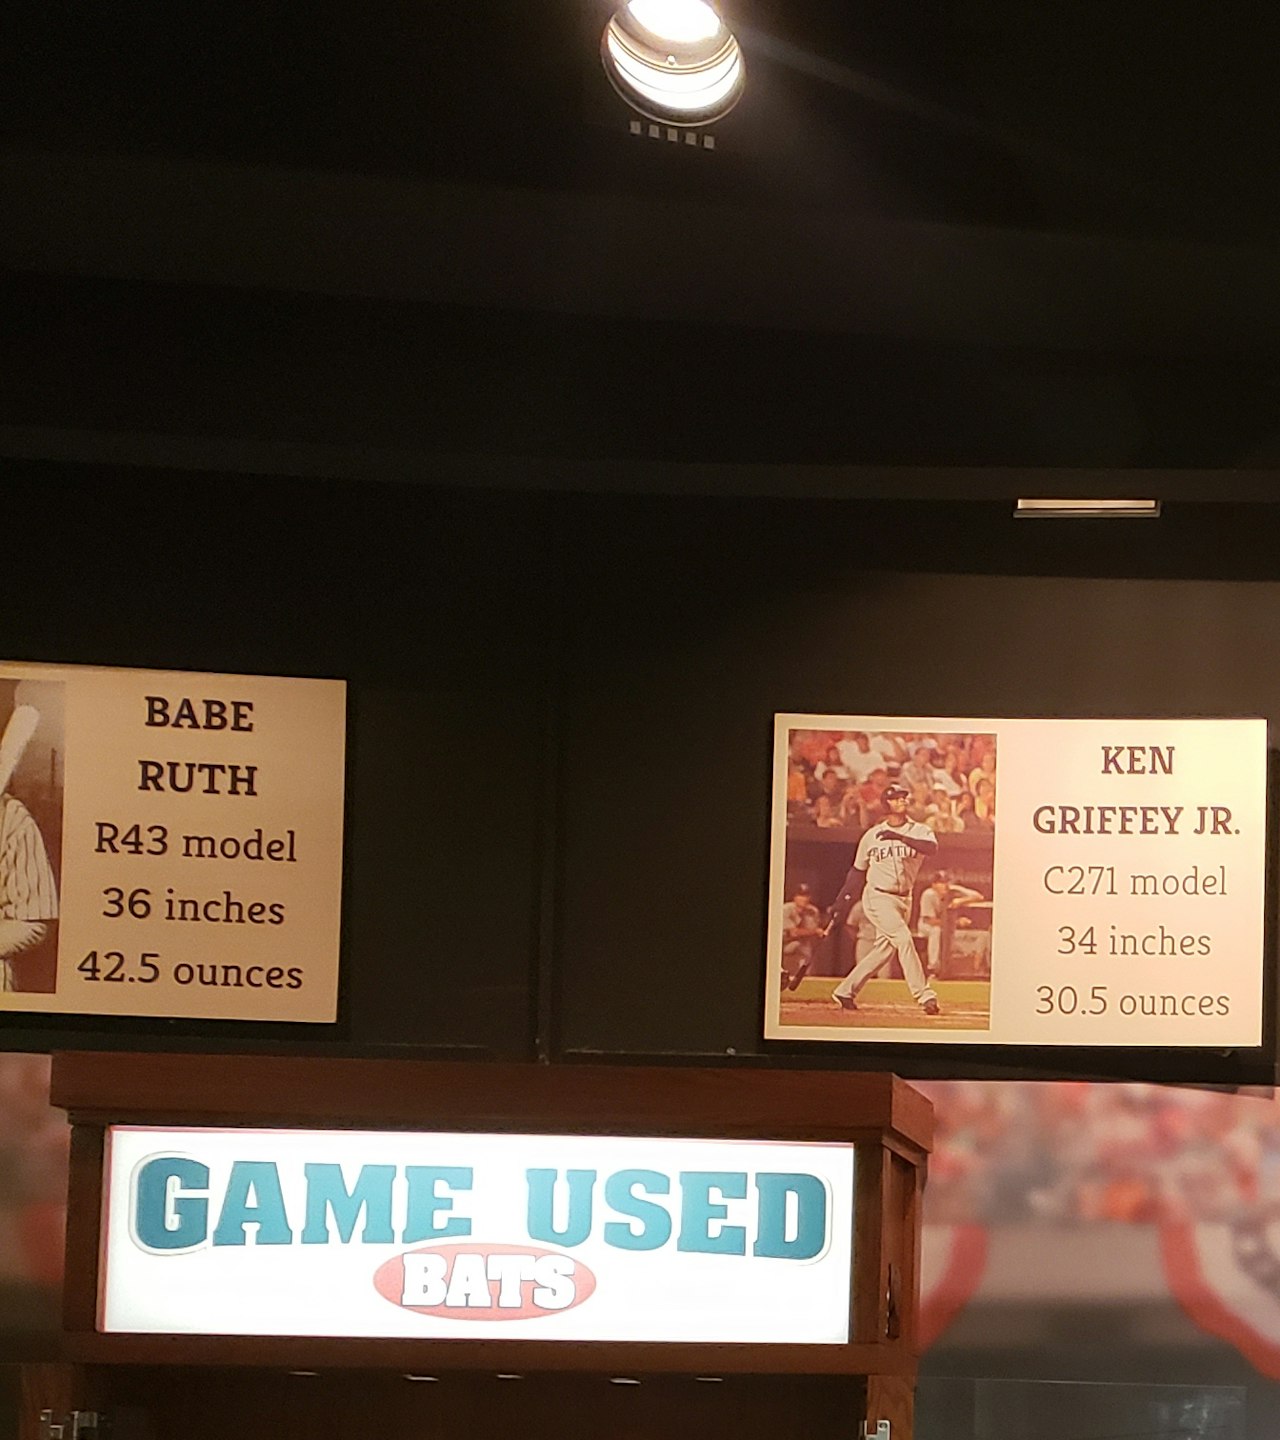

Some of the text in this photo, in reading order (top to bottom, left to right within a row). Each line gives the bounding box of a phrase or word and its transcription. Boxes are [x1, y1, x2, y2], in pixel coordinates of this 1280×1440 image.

[145, 696, 254, 732] BABE
[138, 760, 258, 796] RUTH
[1101, 746, 1174, 774] KEN
[1034, 805, 1240, 835] GRIFFEY JR.
[95, 822, 297, 862] R43 model
[1044, 866, 1226, 896] C271 model
[102, 887, 285, 925] 36 inches
[1058, 926, 1211, 956] 34 inches
[77, 951, 302, 989] 42.5 ounces
[1036, 986, 1229, 1016] 30.5 ounces
[134, 1155, 829, 1261] GAME USED
[401, 1252, 576, 1310] BATS
